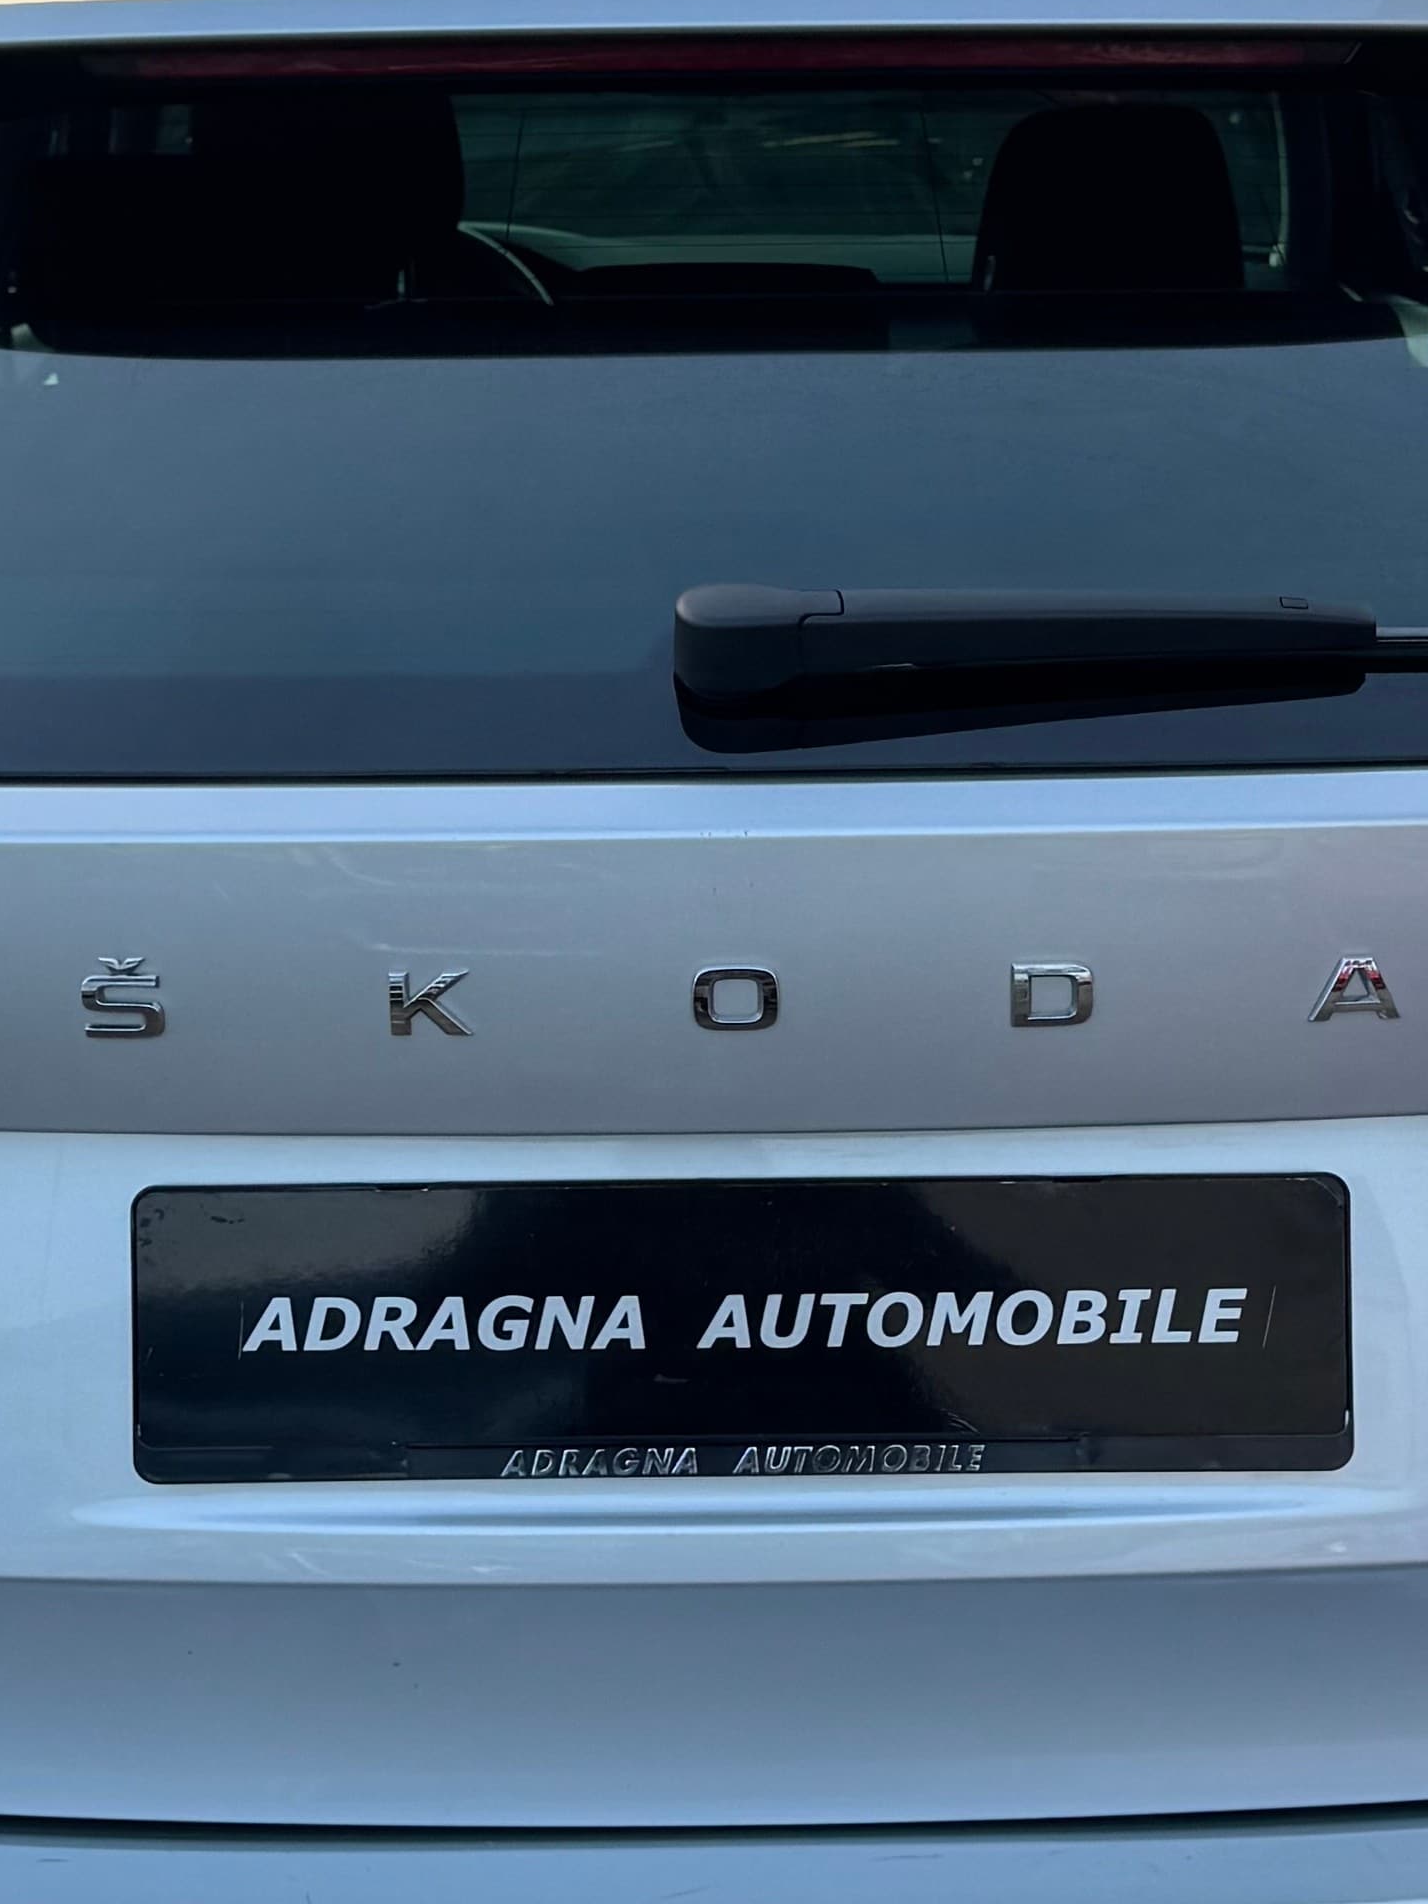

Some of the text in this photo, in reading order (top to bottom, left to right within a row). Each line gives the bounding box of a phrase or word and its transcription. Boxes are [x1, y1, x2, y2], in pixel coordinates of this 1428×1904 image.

[241, 1287, 1250, 1354] ADRAGNA AUTOMOBILE
[499, 1443, 987, 1477] ADRAGNA AUTOMOBILE
